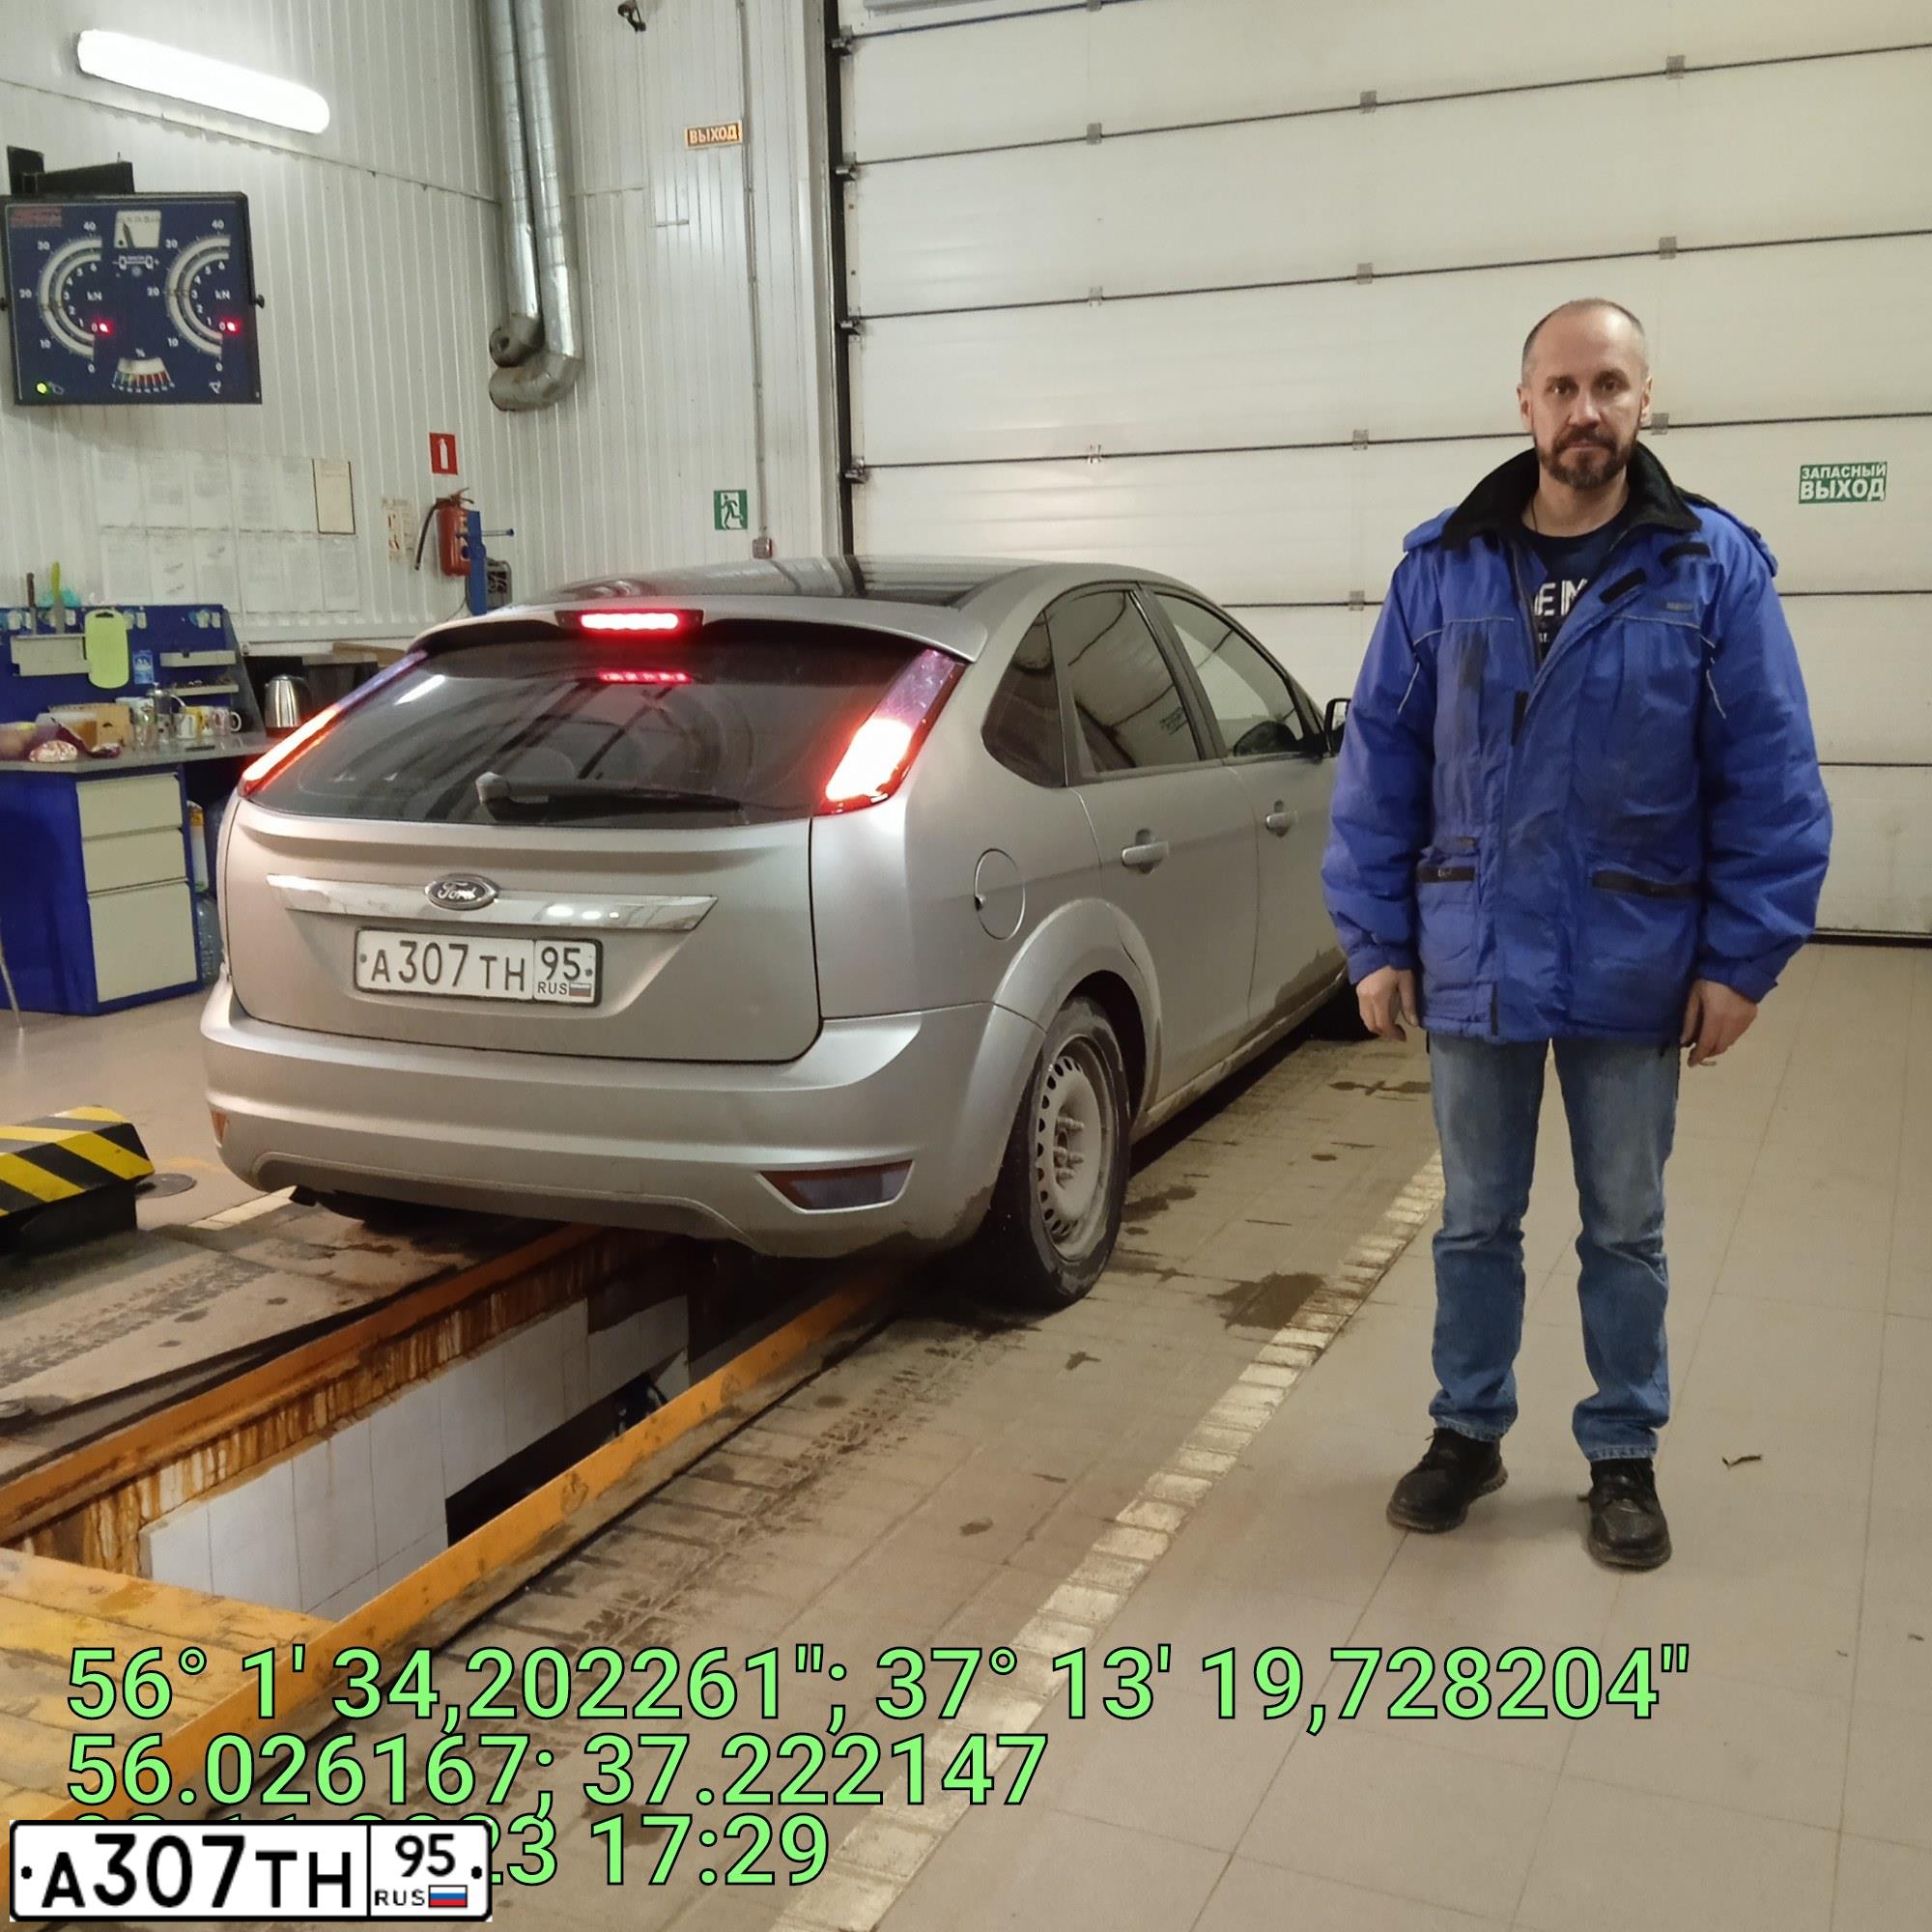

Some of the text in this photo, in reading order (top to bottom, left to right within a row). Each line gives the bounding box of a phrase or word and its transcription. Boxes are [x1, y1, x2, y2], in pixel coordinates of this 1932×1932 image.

[688, 125, 738, 144] ВЫХОД
[83, 221, 97, 231] 40
[212, 219, 224, 229] 40
[37, 241, 50, 250] 30
[165, 239, 178, 248] 30
[19, 288, 33, 298] 20
[147, 287, 160, 297] 20
[214, 290, 231, 299] kN
[40, 339, 51, 349] 10
[168, 338, 179, 347] 10
[87, 363, 96, 374] 0
[215, 362, 223, 372] 0
[1801, 464, 1887, 480] ЗАПАСНЫЙ
[1799, 478, 1887, 501] ВЫХОД
[437, 881, 477, 900] Ford
[540, 946, 582, 981] 95
[537, 981, 568, 996] RUS
